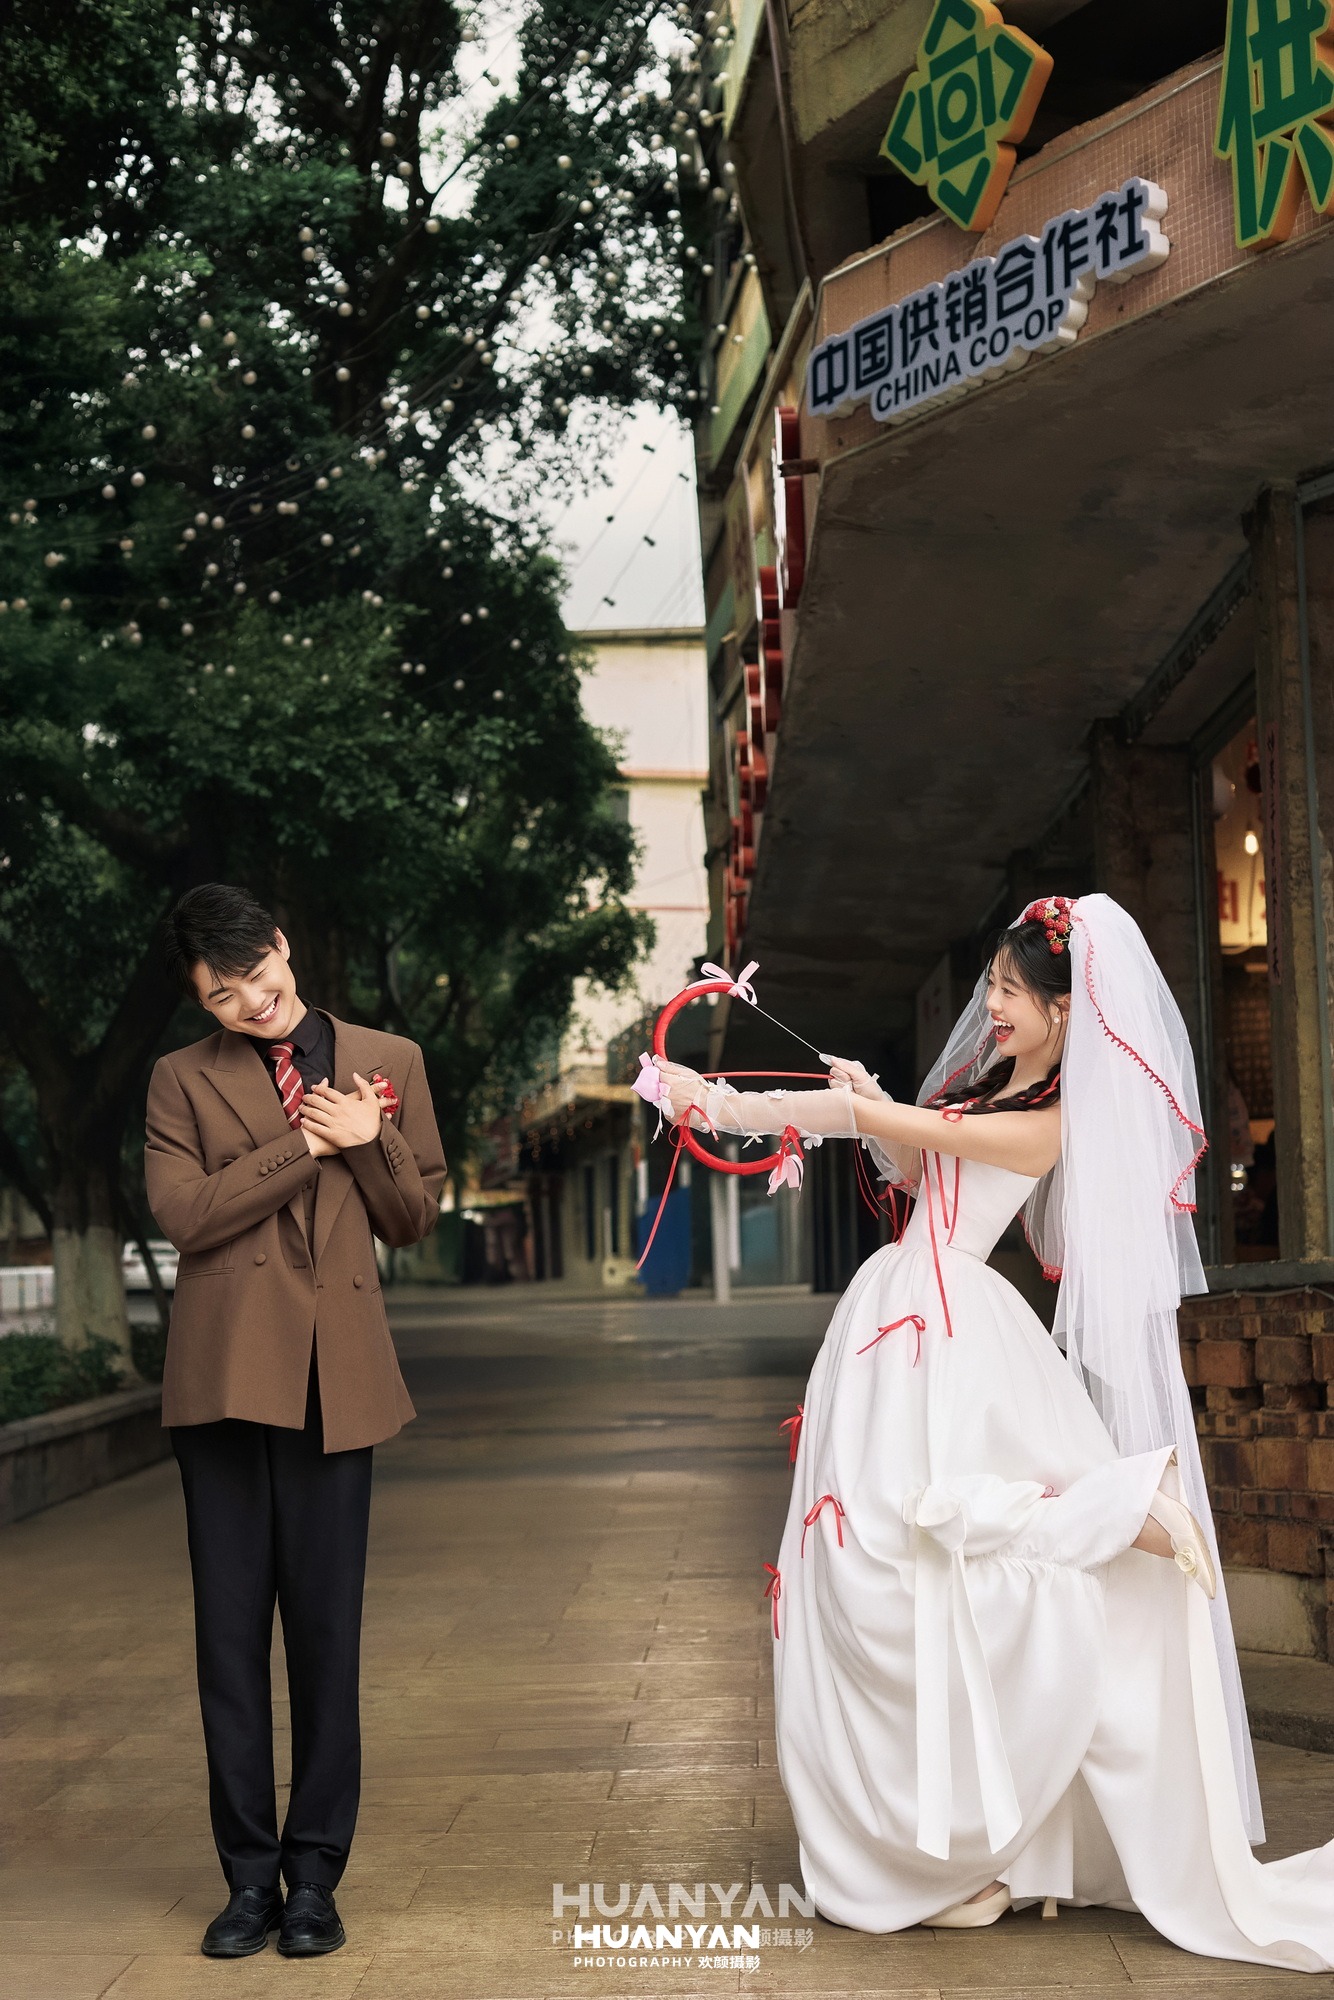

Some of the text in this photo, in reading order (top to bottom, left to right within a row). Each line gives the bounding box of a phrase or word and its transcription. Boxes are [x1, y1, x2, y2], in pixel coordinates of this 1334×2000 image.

[1217, 0, 1334, 243] 供
[811, 186, 1147, 409] 中国供销合作社
[875, 299, 1065, 413] CHINA CO-OP
